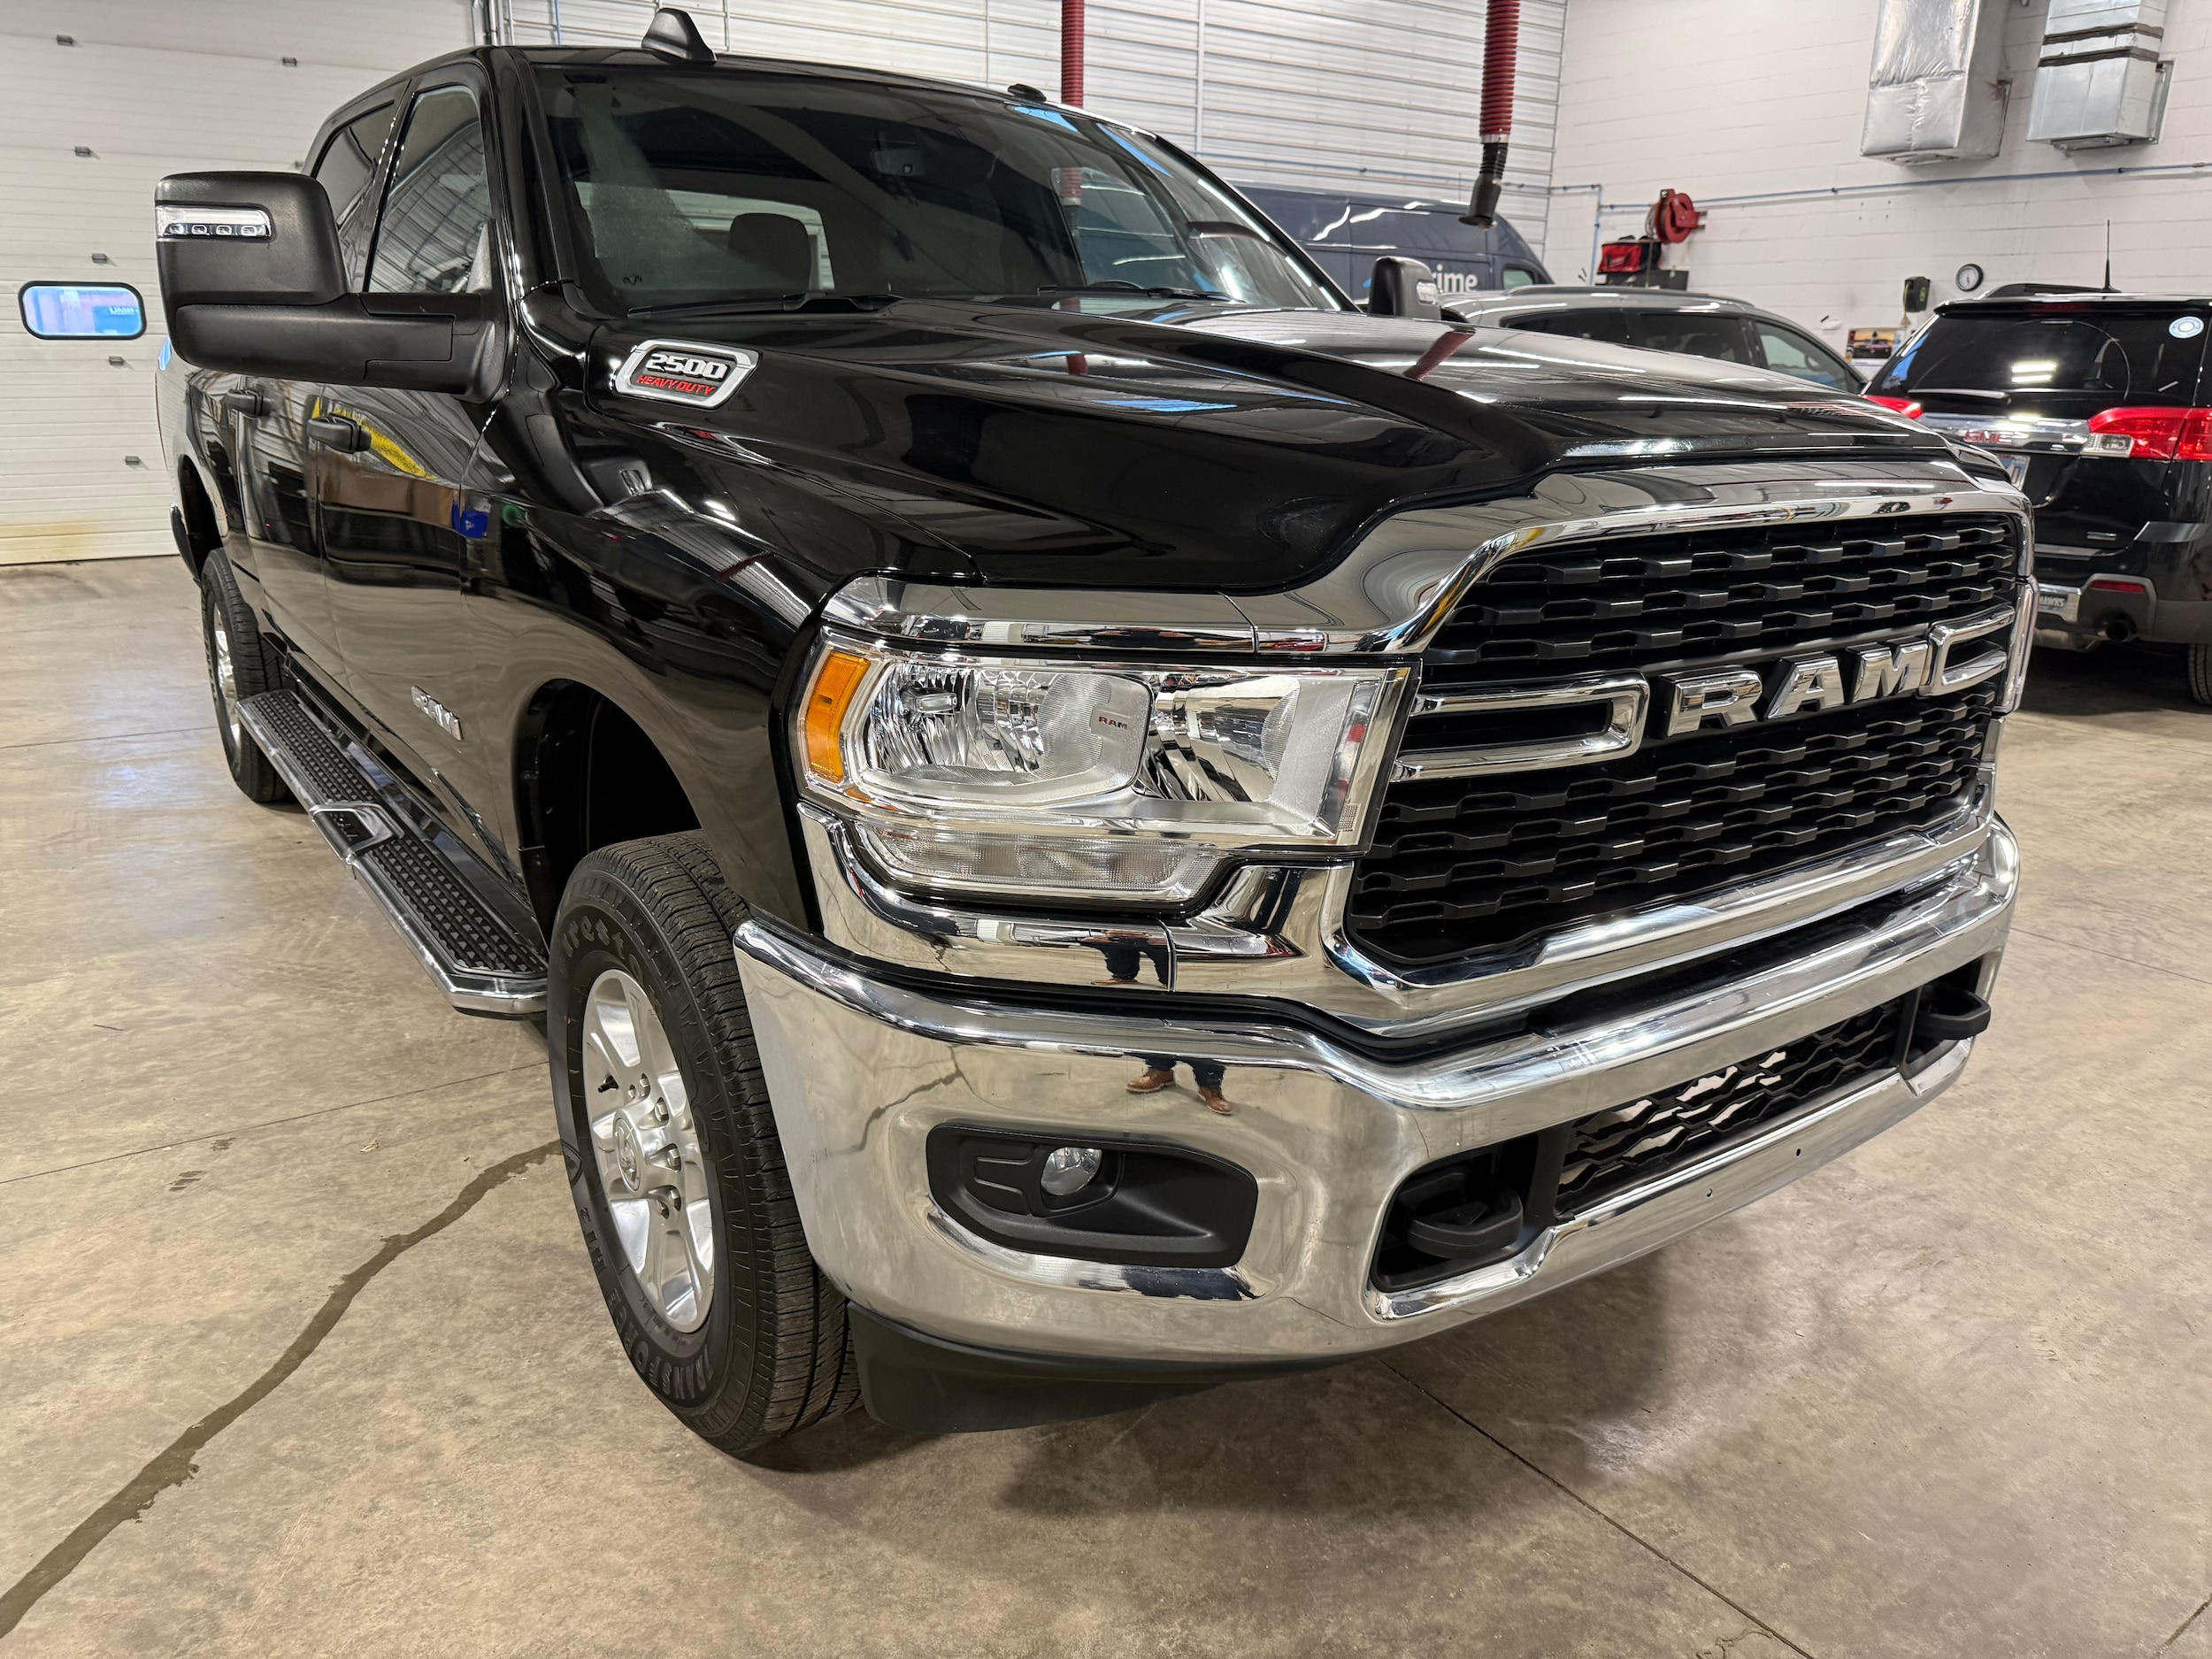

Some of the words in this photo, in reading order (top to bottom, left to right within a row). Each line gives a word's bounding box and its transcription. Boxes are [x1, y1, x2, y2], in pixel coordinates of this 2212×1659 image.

[1431, 264, 1479, 293] ime
[646, 353, 728, 380] 2500
[636, 374, 679, 389] HEAVY
[680, 381, 716, 396] DUTY
[1665, 635, 1929, 737] RAM
[411, 686, 463, 741] RAM
[1098, 716, 1128, 730] RAM
